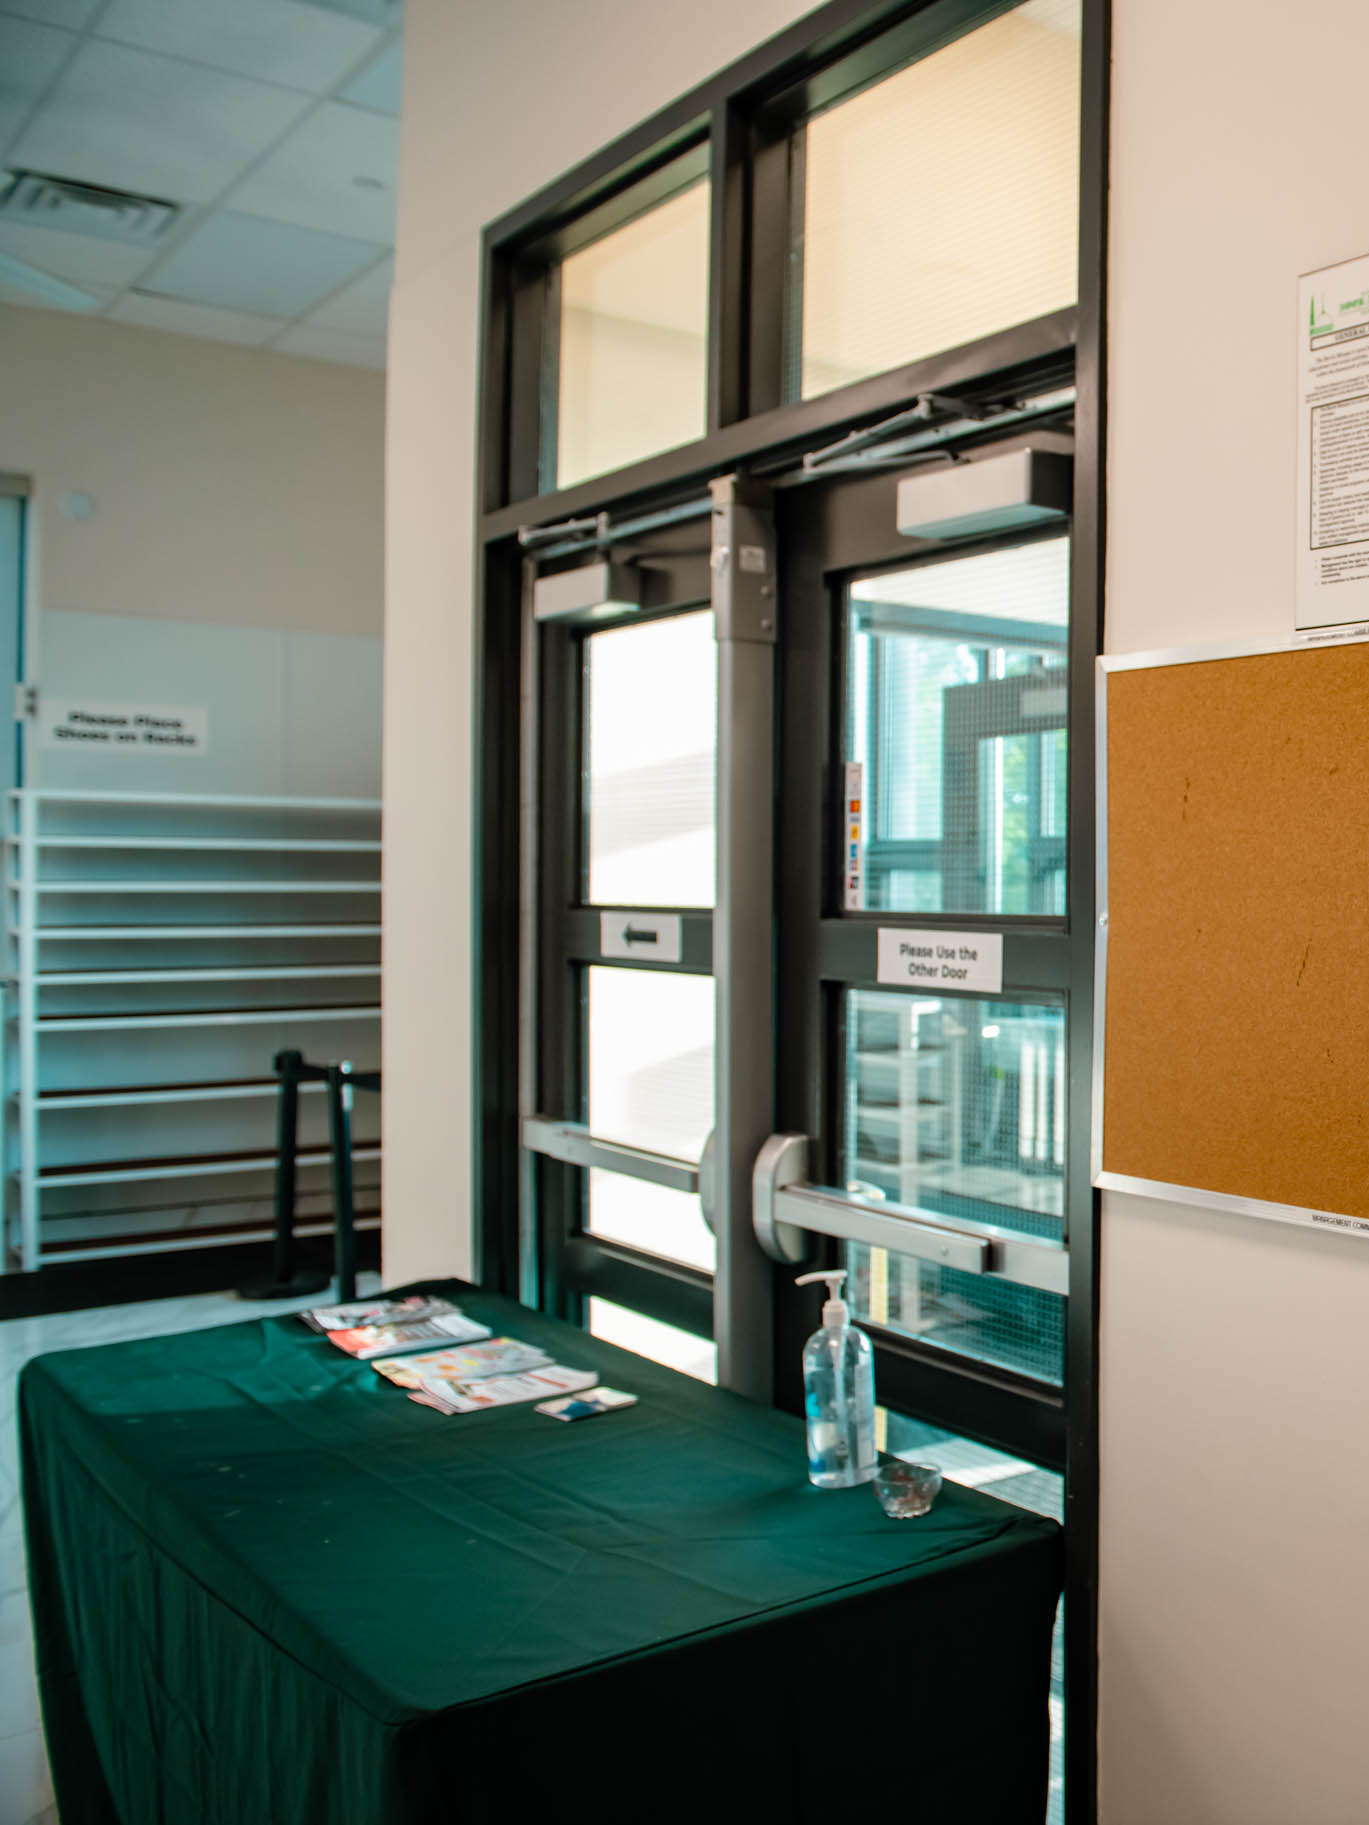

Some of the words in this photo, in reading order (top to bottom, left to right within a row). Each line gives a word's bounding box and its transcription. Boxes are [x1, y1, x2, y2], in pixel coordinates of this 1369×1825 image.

[899, 943, 933, 959] Please
[936, 945, 956, 960] Use
[959, 946, 978, 961] the
[908, 962, 939, 977] Other
[941, 964, 968, 979] Door
